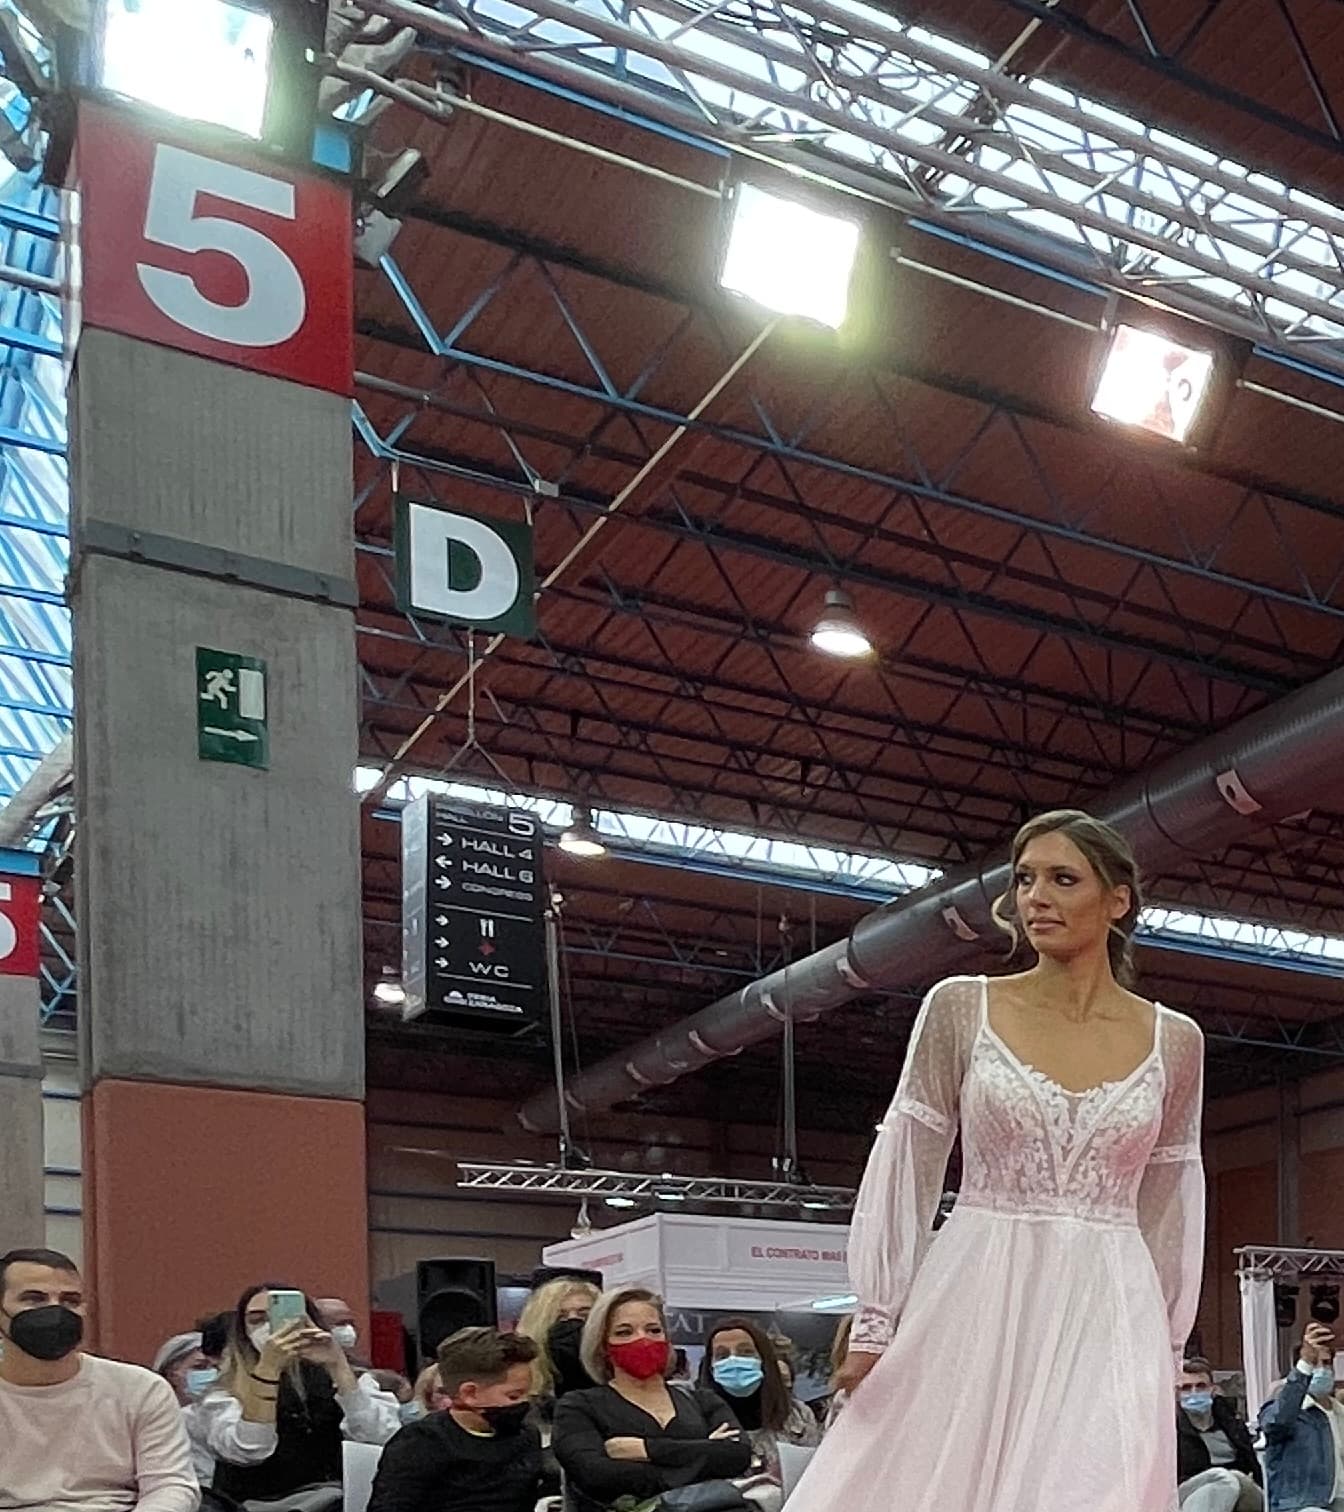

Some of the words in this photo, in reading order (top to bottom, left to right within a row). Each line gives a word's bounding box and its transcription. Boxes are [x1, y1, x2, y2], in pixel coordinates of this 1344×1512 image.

[136, 142, 306, 347] 5
[409, 502, 519, 620] D
[509, 812, 535, 836] 5
[461, 837, 516, 859] HALL
[518, 848, 534, 861] 4
[461, 860, 517, 881] HALL
[518, 870, 535, 884] 6
[468, 961, 510, 978] WC
[766, 1247, 819, 1260] CONTRATO
